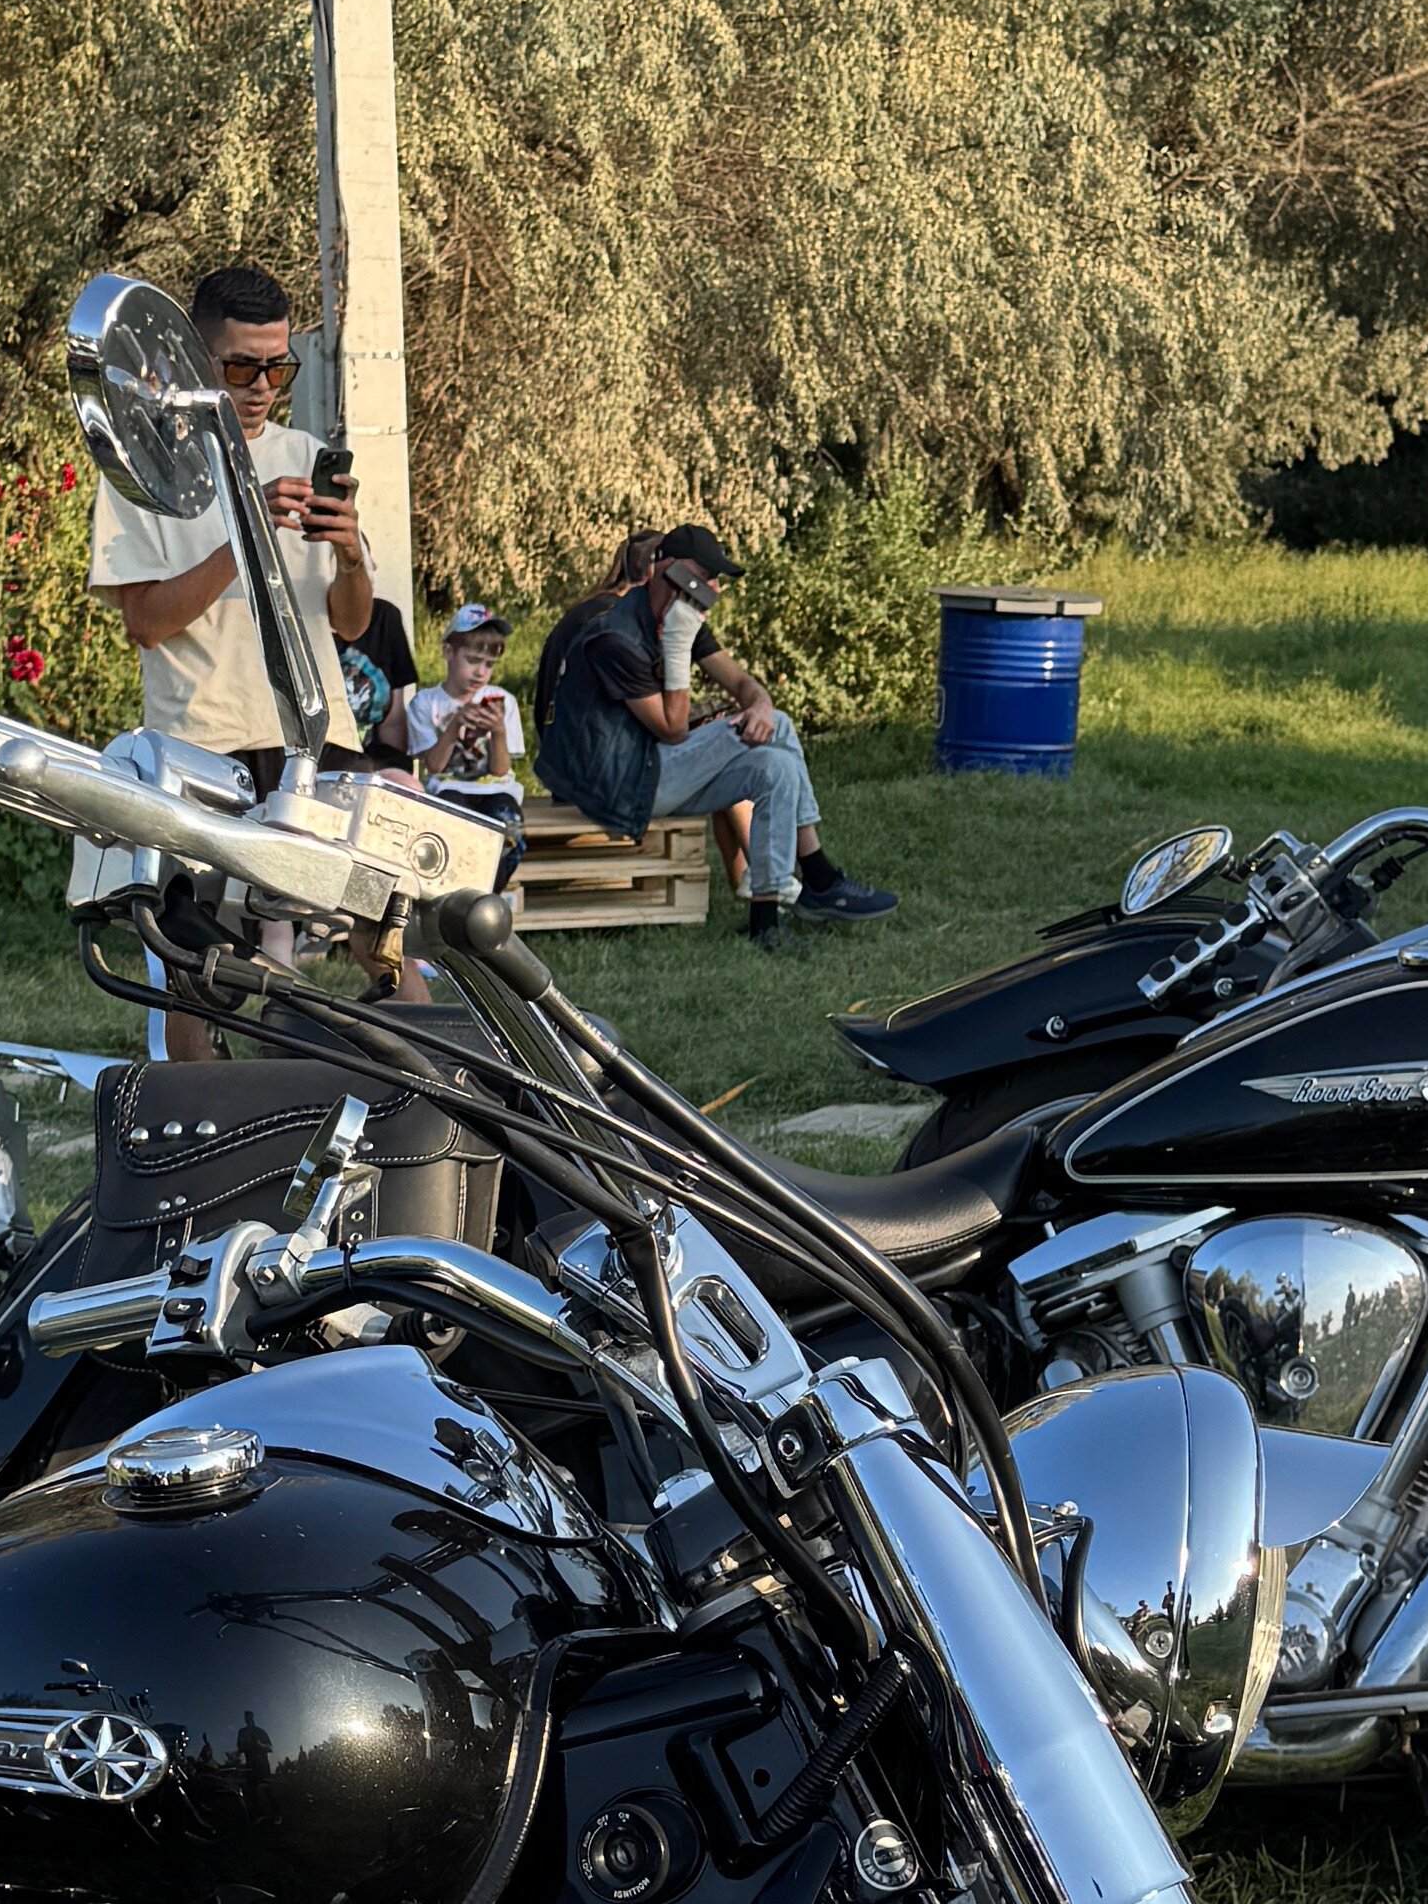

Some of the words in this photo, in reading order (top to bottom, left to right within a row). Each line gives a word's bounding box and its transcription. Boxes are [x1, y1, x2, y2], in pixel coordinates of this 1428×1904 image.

[1292, 1077, 1355, 1102] Road
[1358, 1077, 1414, 1101] Star
[613, 1877, 651, 1899] IGNITION
